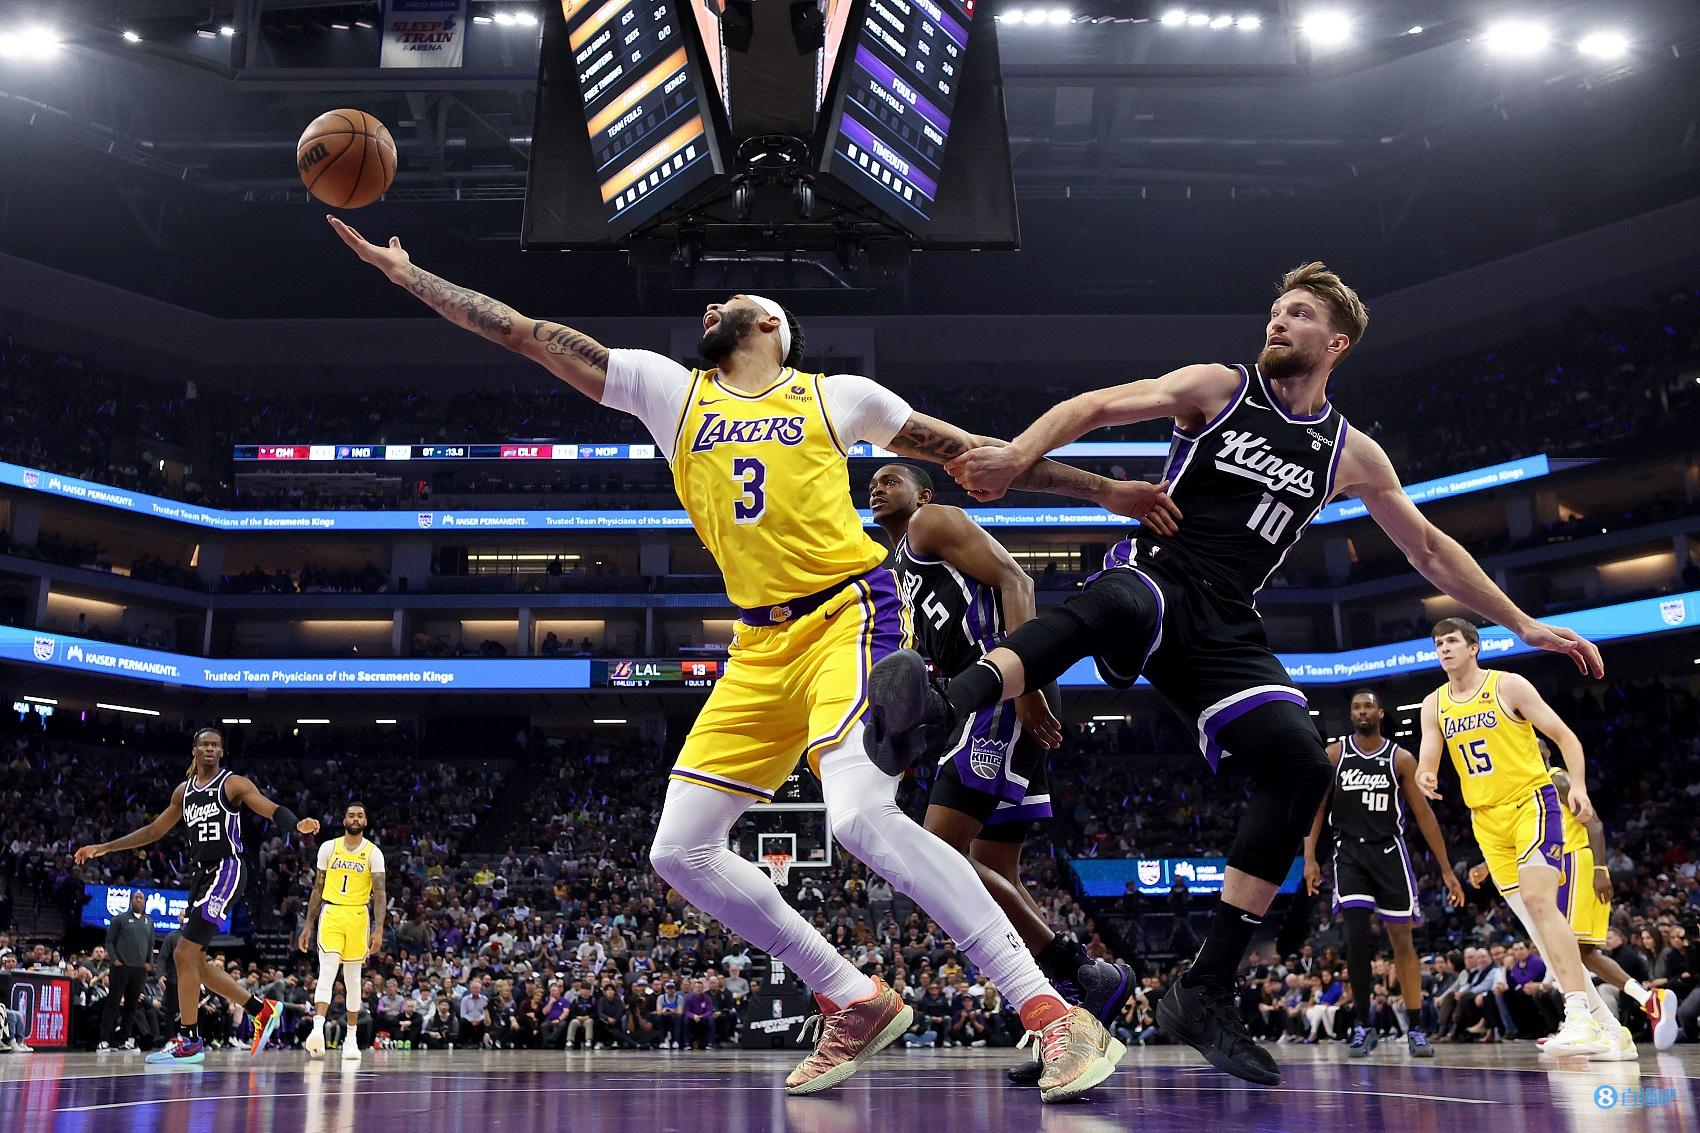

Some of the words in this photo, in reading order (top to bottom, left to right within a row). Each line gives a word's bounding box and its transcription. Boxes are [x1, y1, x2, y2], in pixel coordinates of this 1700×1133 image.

[392, 22, 442, 31] SLEEP
[402, 32, 454, 42] TRAIN
[866, 17, 882, 37] FREE
[580, 50, 614, 83] 3-POINTERS
[584, 84, 600, 102] FREE
[664, 72, 687, 94] BONUS
[892, 78, 917, 105] FOULS
[870, 80, 886, 99] TEAM
[885, 95, 905, 114] FOULS
[608, 118, 625, 138] TEAM
[624, 106, 643, 126] FOULS
[923, 124, 943, 146] BONUS
[872, 139, 910, 176] TIMEOUTS
[785, 394, 812, 402] bibigo
[691, 413, 805, 452] LAKERS
[1306, 428, 1333, 446] dialpad
[352, 448, 370, 457] IND
[518, 448, 538, 456] CLE
[1214, 430, 1315, 495] Kings
[732, 456, 766, 524] 3
[1450, 474, 1499, 491] Sacramento
[1499, 468, 1524, 480] Kings
[62, 484, 86, 496] KAISER
[87, 489, 133, 506] PERMANENTE
[152, 503, 180, 516] Trusted
[180, 509, 200, 520] Team
[200, 513, 239, 526] Physicians
[240, 518, 249, 526] of
[250, 518, 262, 526] the
[263, 518, 310, 526] Sacramento
[311, 518, 334, 527] Kings
[455, 518, 479, 526] KAISER
[479, 518, 526, 526] PERMANENTE
[546, 517, 574, 525] Trusted
[575, 517, 595, 525] Team
[597, 517, 636, 526] Physicians
[638, 517, 647, 525] of
[648, 517, 660, 525] the
[995, 515, 1034, 524] Physicians
[1246, 492, 1294, 544] 10
[922, 591, 950, 630] 5
[1481, 638, 1514, 652] Kings
[86, 652, 116, 667] KAISER
[118, 656, 177, 676] PERMANENTE
[635, 664, 660, 676] LAL
[691, 664, 706, 676] 13
[1307, 665, 1333, 676] Team
[1334, 660, 1385, 675] Physicians
[1386, 657, 1396, 667] of
[1397, 655, 1415, 666] the
[204, 670, 240, 681] Trusted
[243, 670, 269, 681] Team
[271, 670, 323, 684] Physicians
[325, 670, 337, 681] of
[338, 670, 355, 681] the
[357, 670, 421, 682] Sacramento
[422, 670, 454, 684] Kings
[1443, 710, 1498, 739] LAKERS
[1458, 740, 1493, 776] 15
[1340, 768, 1390, 791] Kings
[1362, 791, 1389, 812] 40
[185, 802, 220, 827] Kings
[198, 822, 220, 842] 23
[331, 858, 365, 872] LAKERS
[340, 874, 348, 893] 1
[40, 984, 52, 1012] ALL
[53, 986, 61, 1012] IN
[37, 1013, 50, 1040] THE
